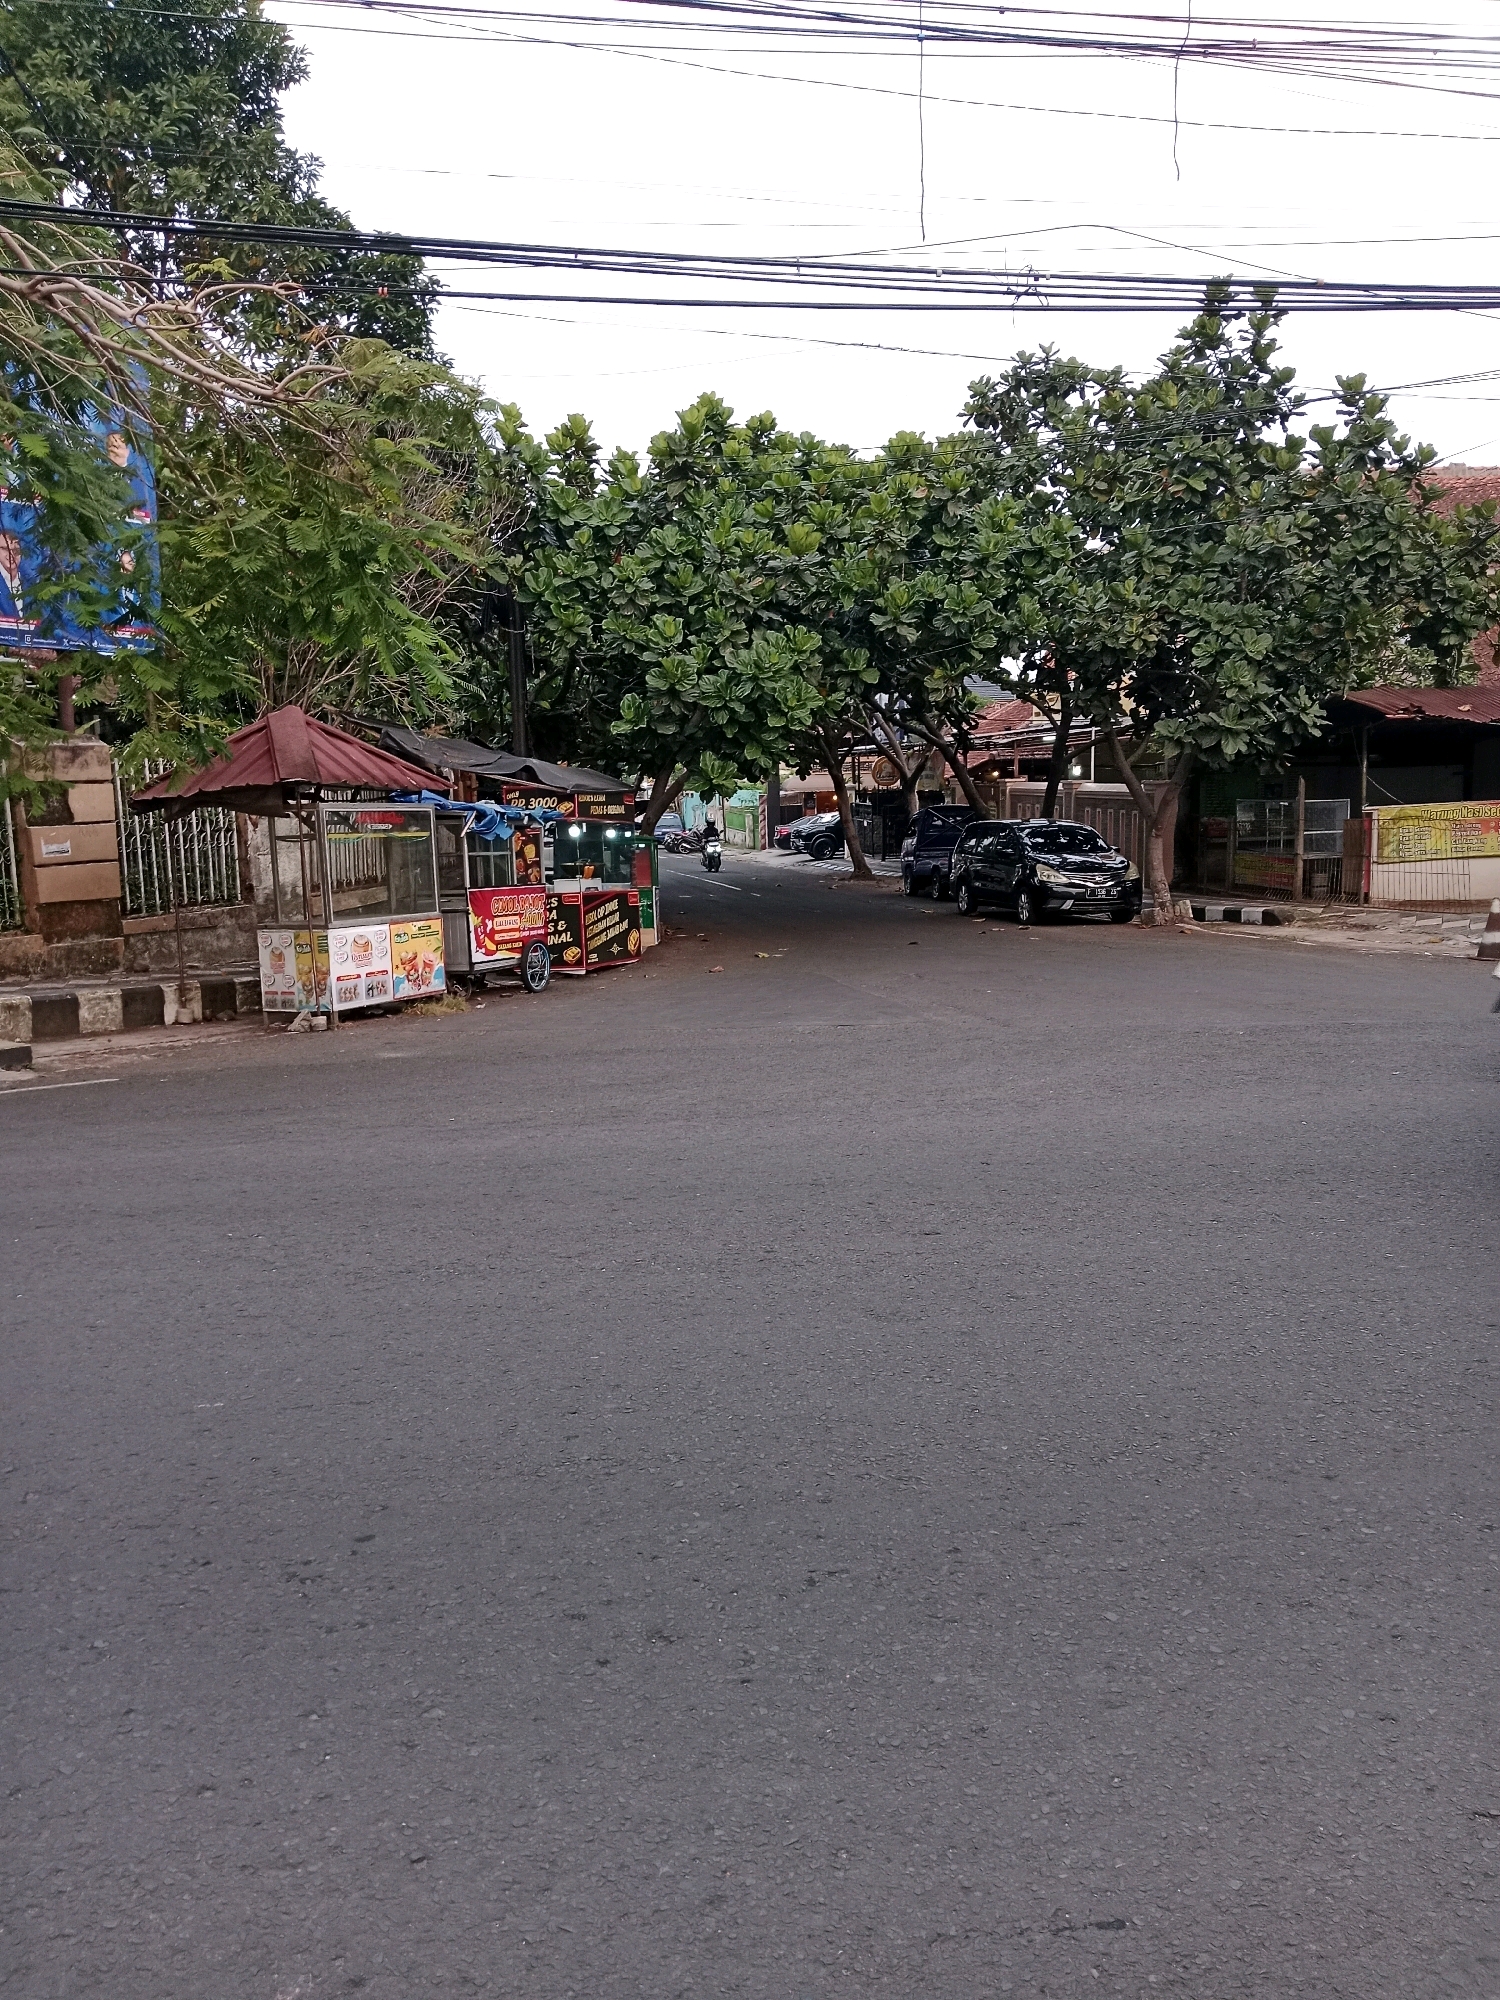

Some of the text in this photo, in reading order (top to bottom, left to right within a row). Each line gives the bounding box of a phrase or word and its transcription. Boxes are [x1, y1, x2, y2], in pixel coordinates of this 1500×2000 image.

[528, 797, 557, 809] 3000
[1421, 808, 1460, 821] Warung
[1460, 805, 1483, 818] Nasi
[557, 920, 567, 931] &
